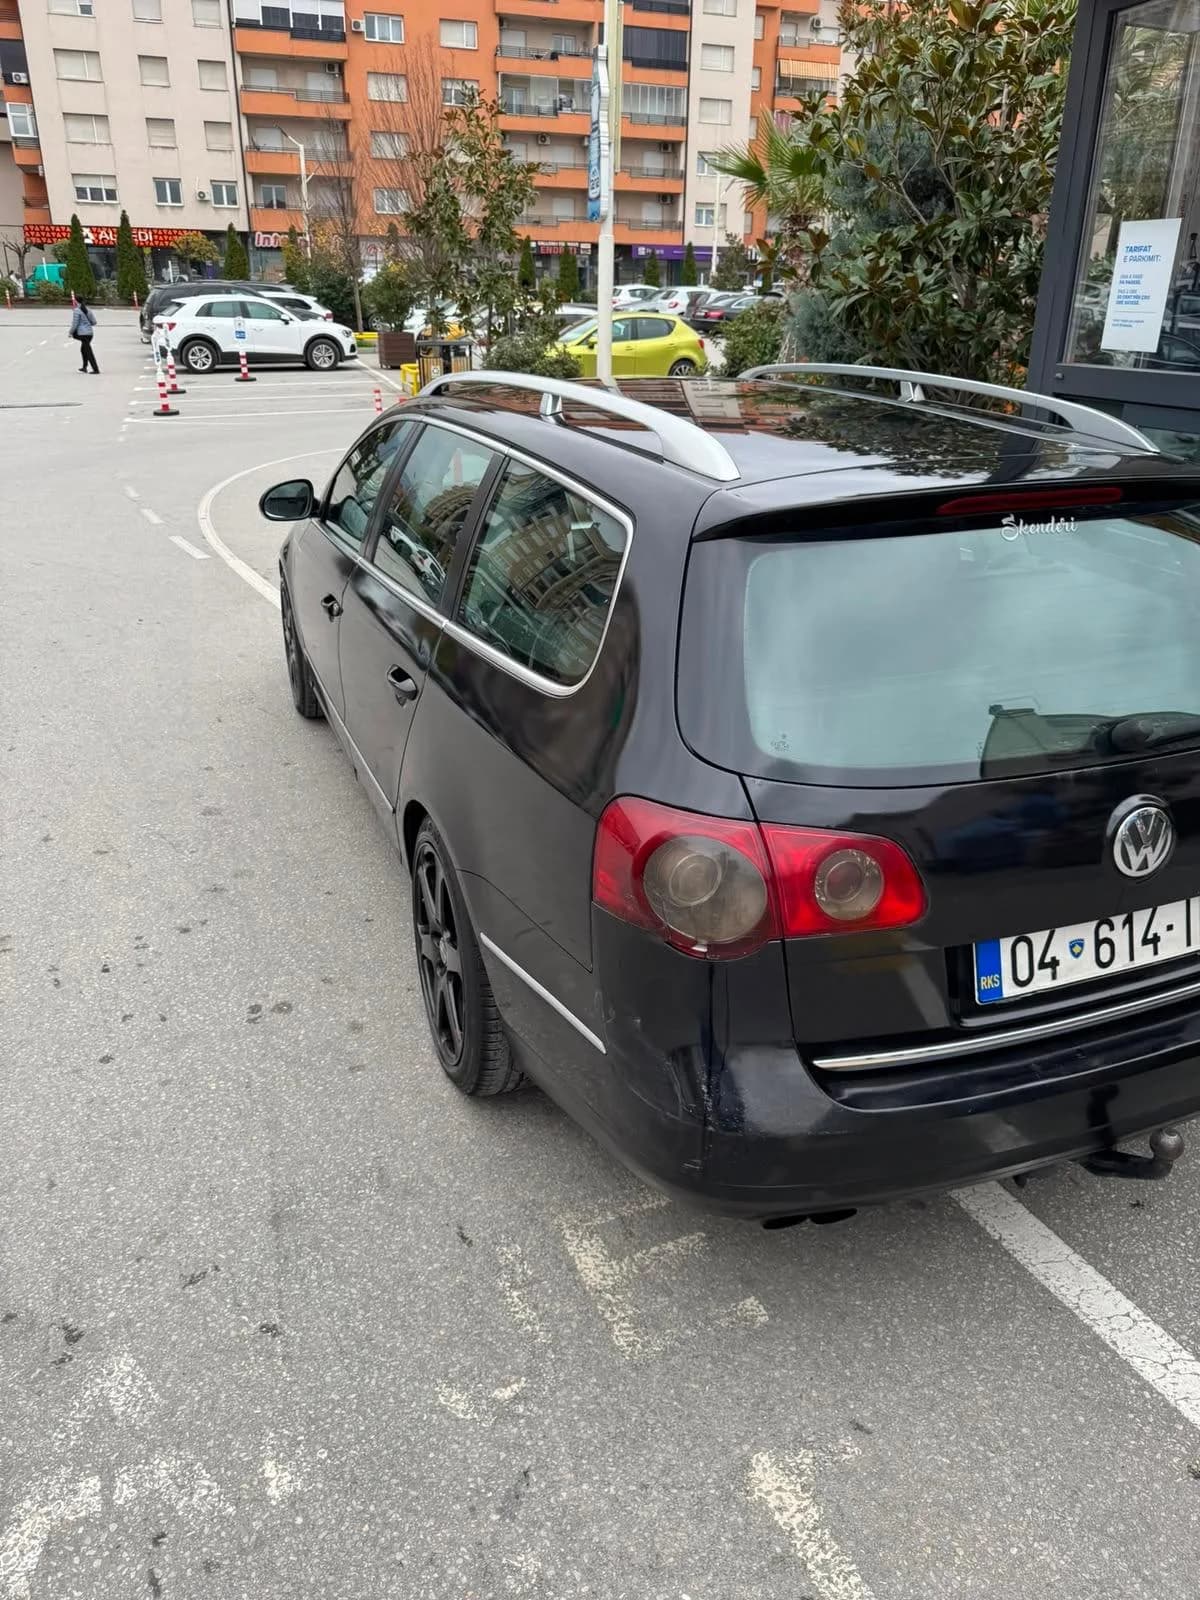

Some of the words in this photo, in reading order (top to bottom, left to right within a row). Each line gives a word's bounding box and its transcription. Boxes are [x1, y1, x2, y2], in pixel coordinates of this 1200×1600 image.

[1125, 245, 1152, 253] TARIFAT
[1123, 255, 1128, 263] E
[1113, 807, 1172, 877] VW
[1010, 929, 1060, 988] 04
[980, 973, 1001, 991] RKS
